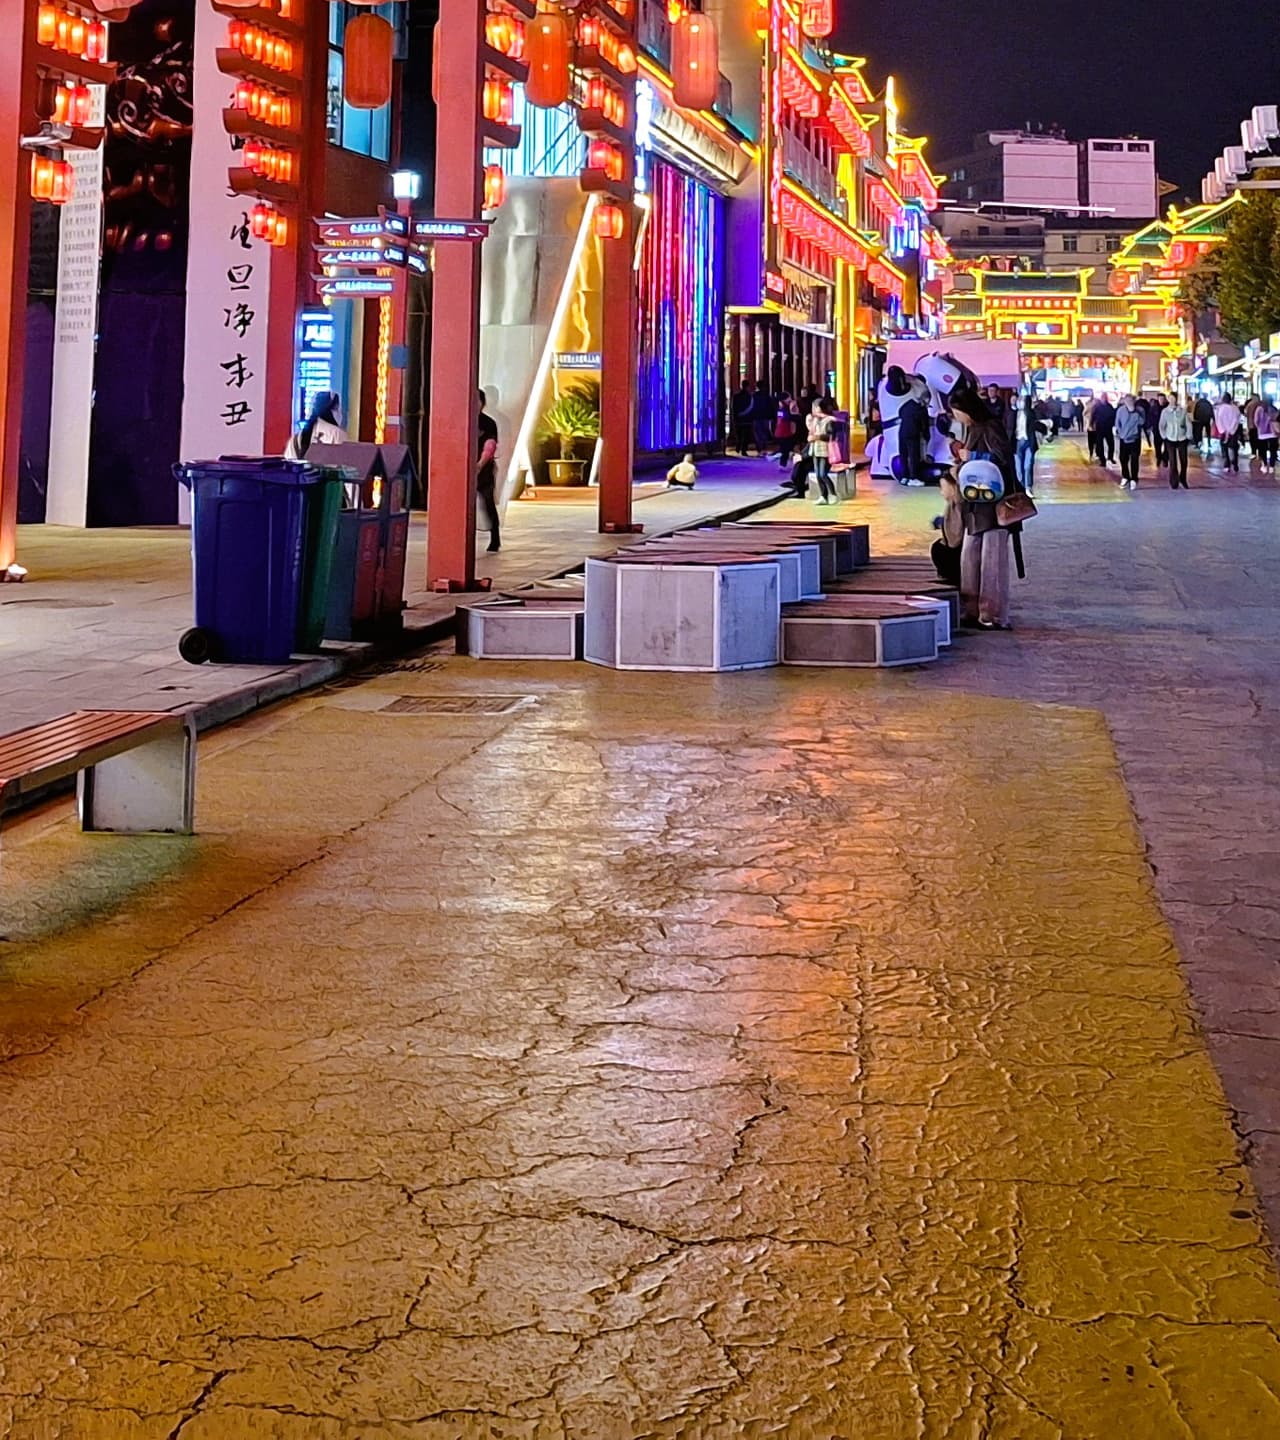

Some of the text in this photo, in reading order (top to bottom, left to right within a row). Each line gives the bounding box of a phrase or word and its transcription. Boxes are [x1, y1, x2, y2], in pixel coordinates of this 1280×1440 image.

[219, 92, 255, 426] 生旦净末丑
